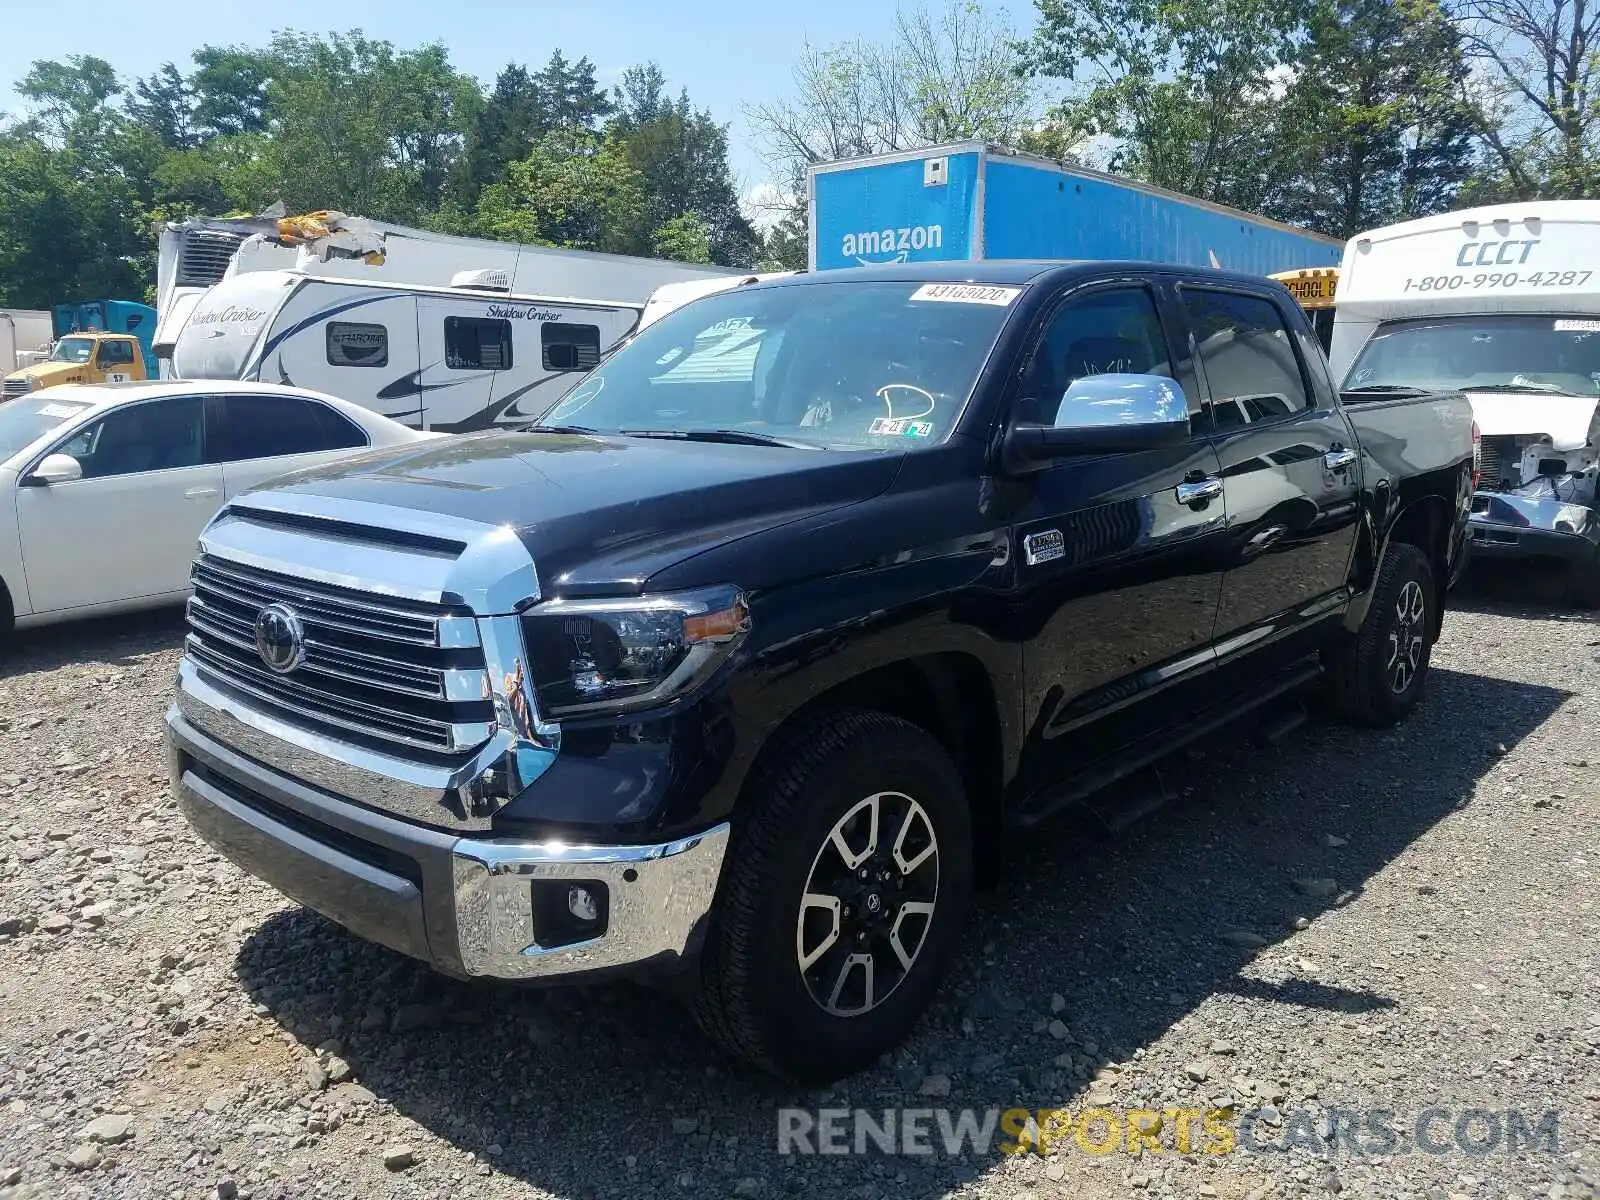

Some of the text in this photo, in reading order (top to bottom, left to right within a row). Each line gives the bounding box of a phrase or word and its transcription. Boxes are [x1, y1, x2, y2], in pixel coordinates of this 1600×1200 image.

[842, 224, 942, 256] amazon
[1456, 240, 1540, 267] CCCT
[1404, 271, 1592, 293] 1-800-990-4287
[220, 305, 266, 322] Cruiser
[486, 305, 562, 320] Shadow Cruiser
